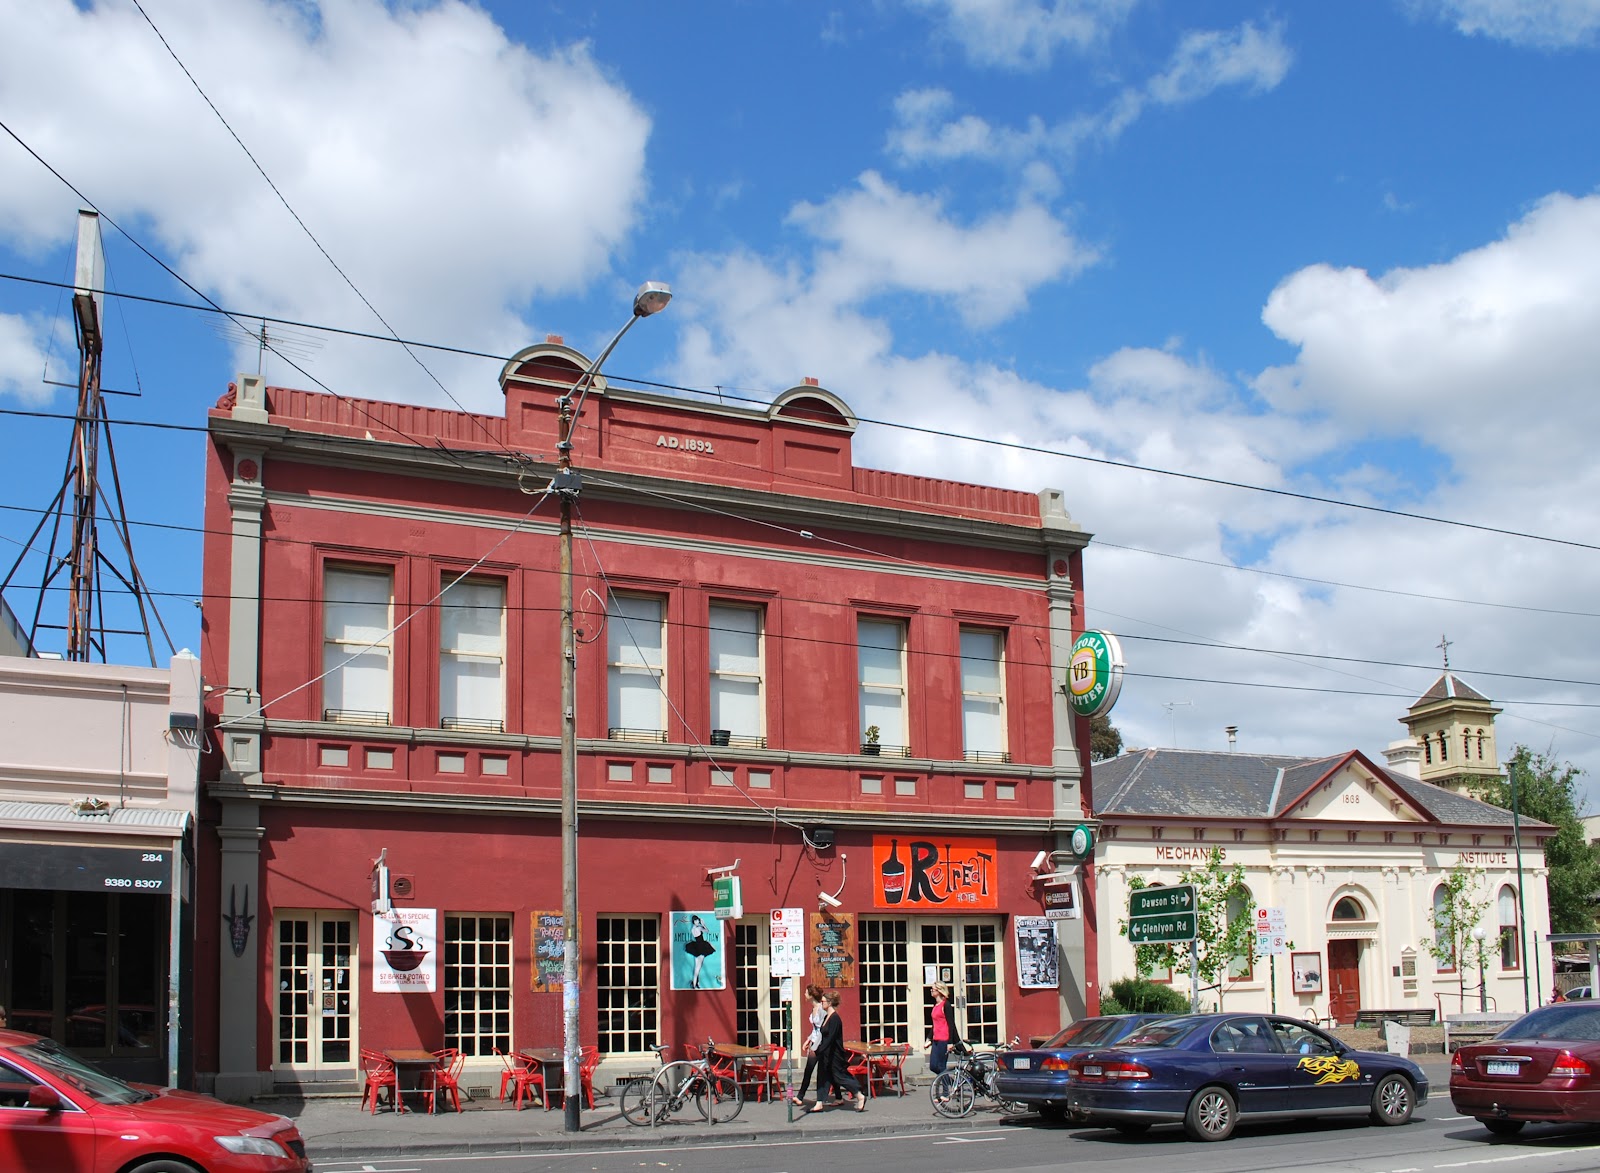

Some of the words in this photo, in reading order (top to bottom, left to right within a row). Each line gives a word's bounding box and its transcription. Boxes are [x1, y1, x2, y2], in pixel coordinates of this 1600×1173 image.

[1066, 637, 1105, 668] VICTORIA
[1073, 661, 1089, 681] VB
[1069, 682, 1105, 706] BITTER
[1342, 794, 1359, 804] 1868
[141, 853, 163, 863] 284
[104, 878, 132, 888] 9380
[134, 879, 163, 889] 8307
[956, 893, 979, 903] HOTEL
[1141, 897, 1168, 909] Dawson
[1170, 894, 1179, 905] St
[1142, 923, 1174, 935] Glenlyon
[1176, 921, 1187, 931] Rd
[774, 945, 785, 954] 1P
[791, 945, 801, 954] 1P
